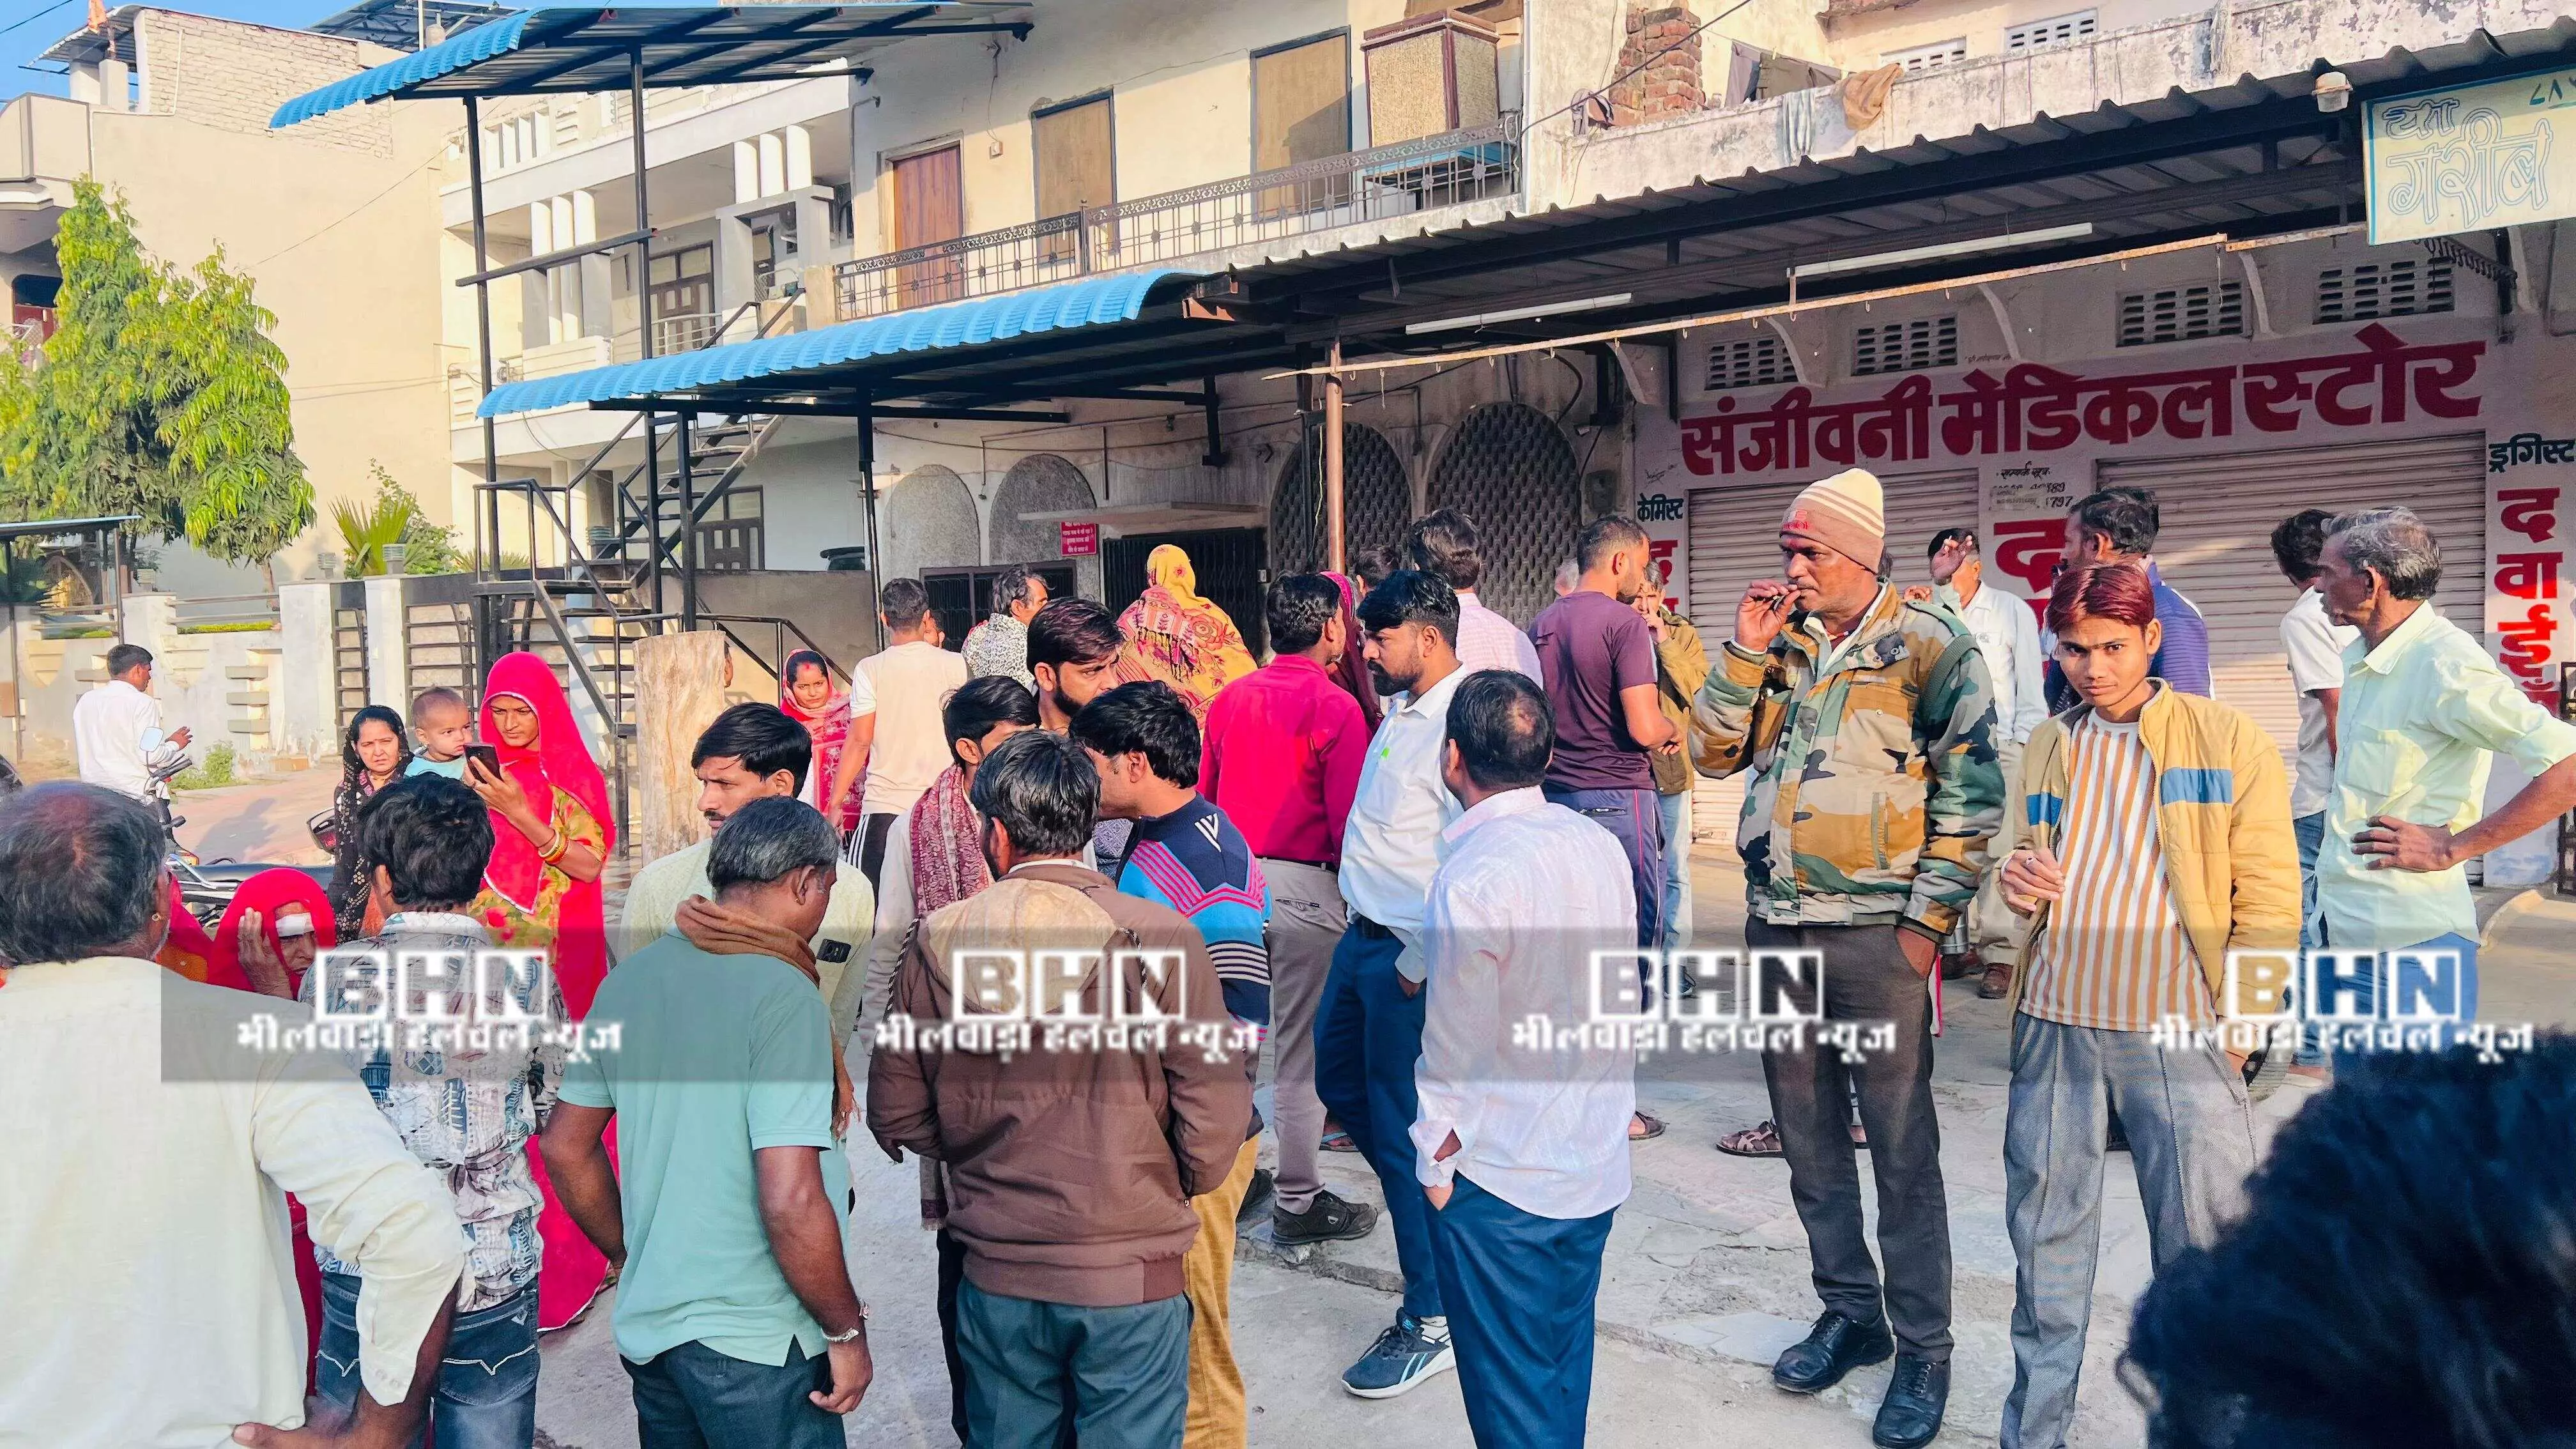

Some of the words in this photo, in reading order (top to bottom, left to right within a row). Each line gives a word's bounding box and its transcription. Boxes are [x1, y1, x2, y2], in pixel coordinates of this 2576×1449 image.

[1680, 375, 1933, 477] संजीवनी
[1938, 363, 2237, 456] मेडिकल
[2242, 322, 2487, 432] स्टोर
[1637, 492, 1684, 522] केमिस्ट
